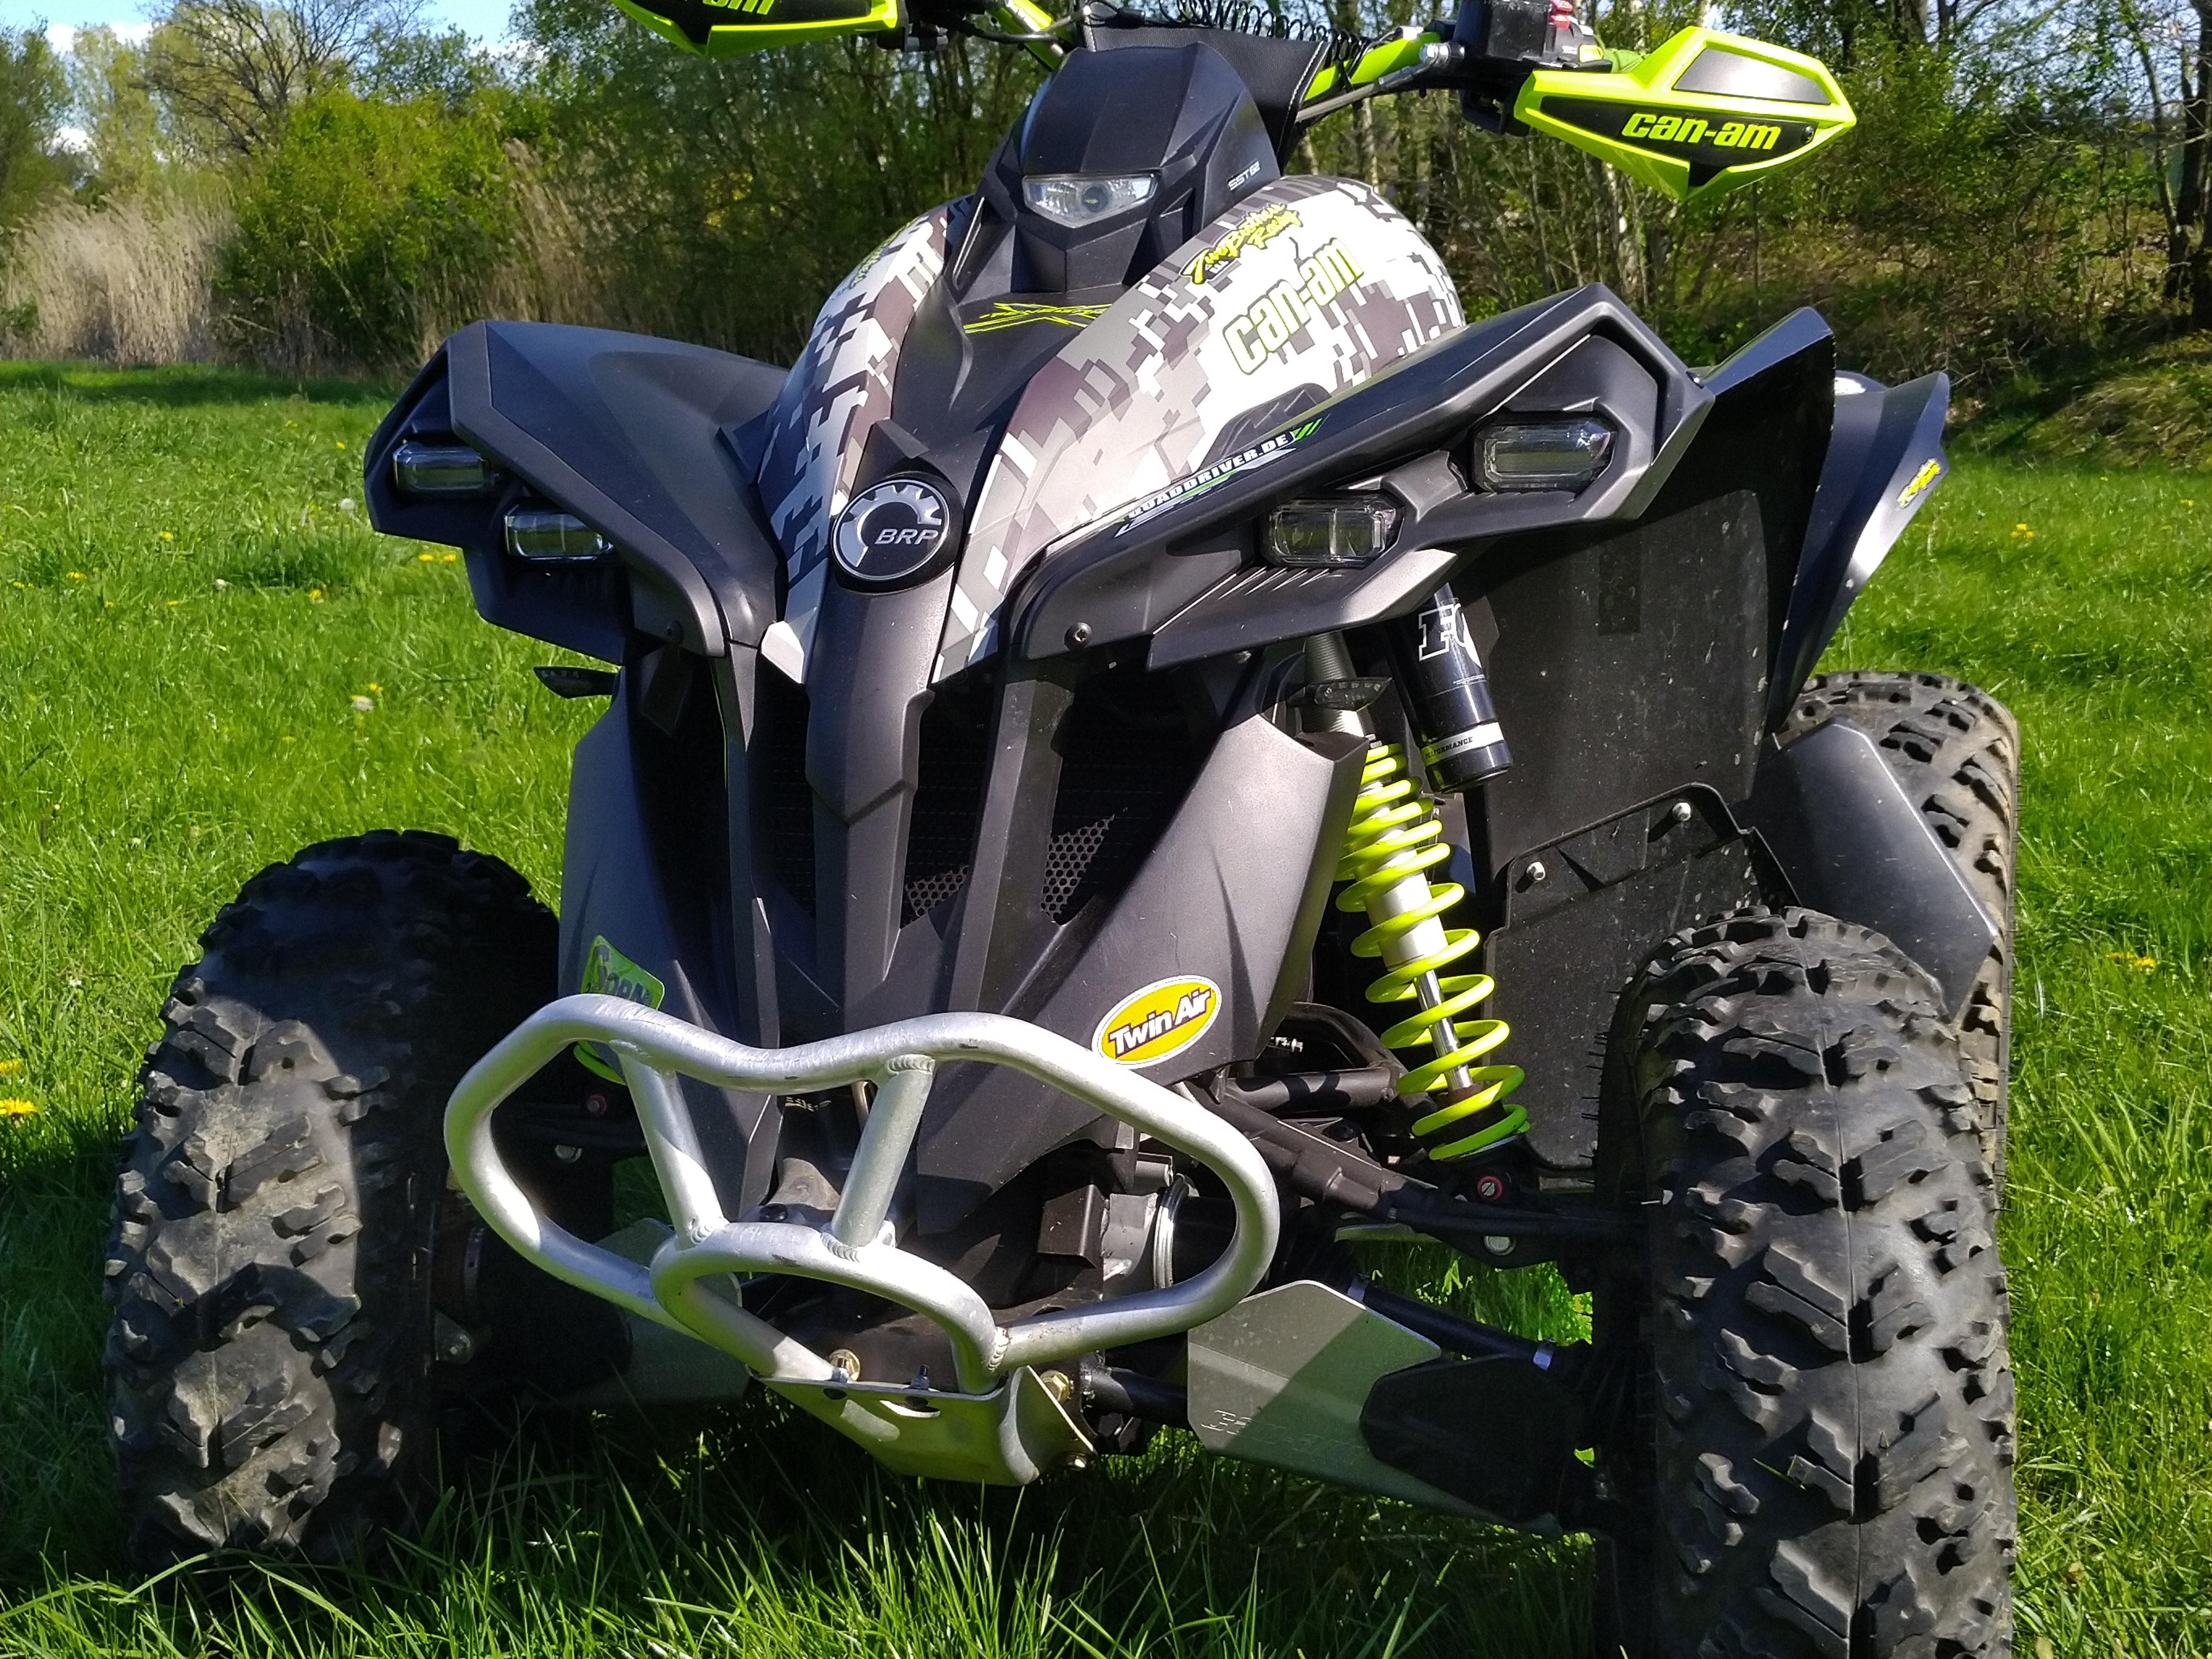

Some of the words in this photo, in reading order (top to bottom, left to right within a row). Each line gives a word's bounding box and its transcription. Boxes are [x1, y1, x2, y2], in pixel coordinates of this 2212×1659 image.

[1128, 433, 1289, 519] QUADDRIVER.DE
[875, 528, 939, 545] BRP
[1108, 1010, 1173, 1059] Twin
[1174, 987, 1213, 1025] Air
